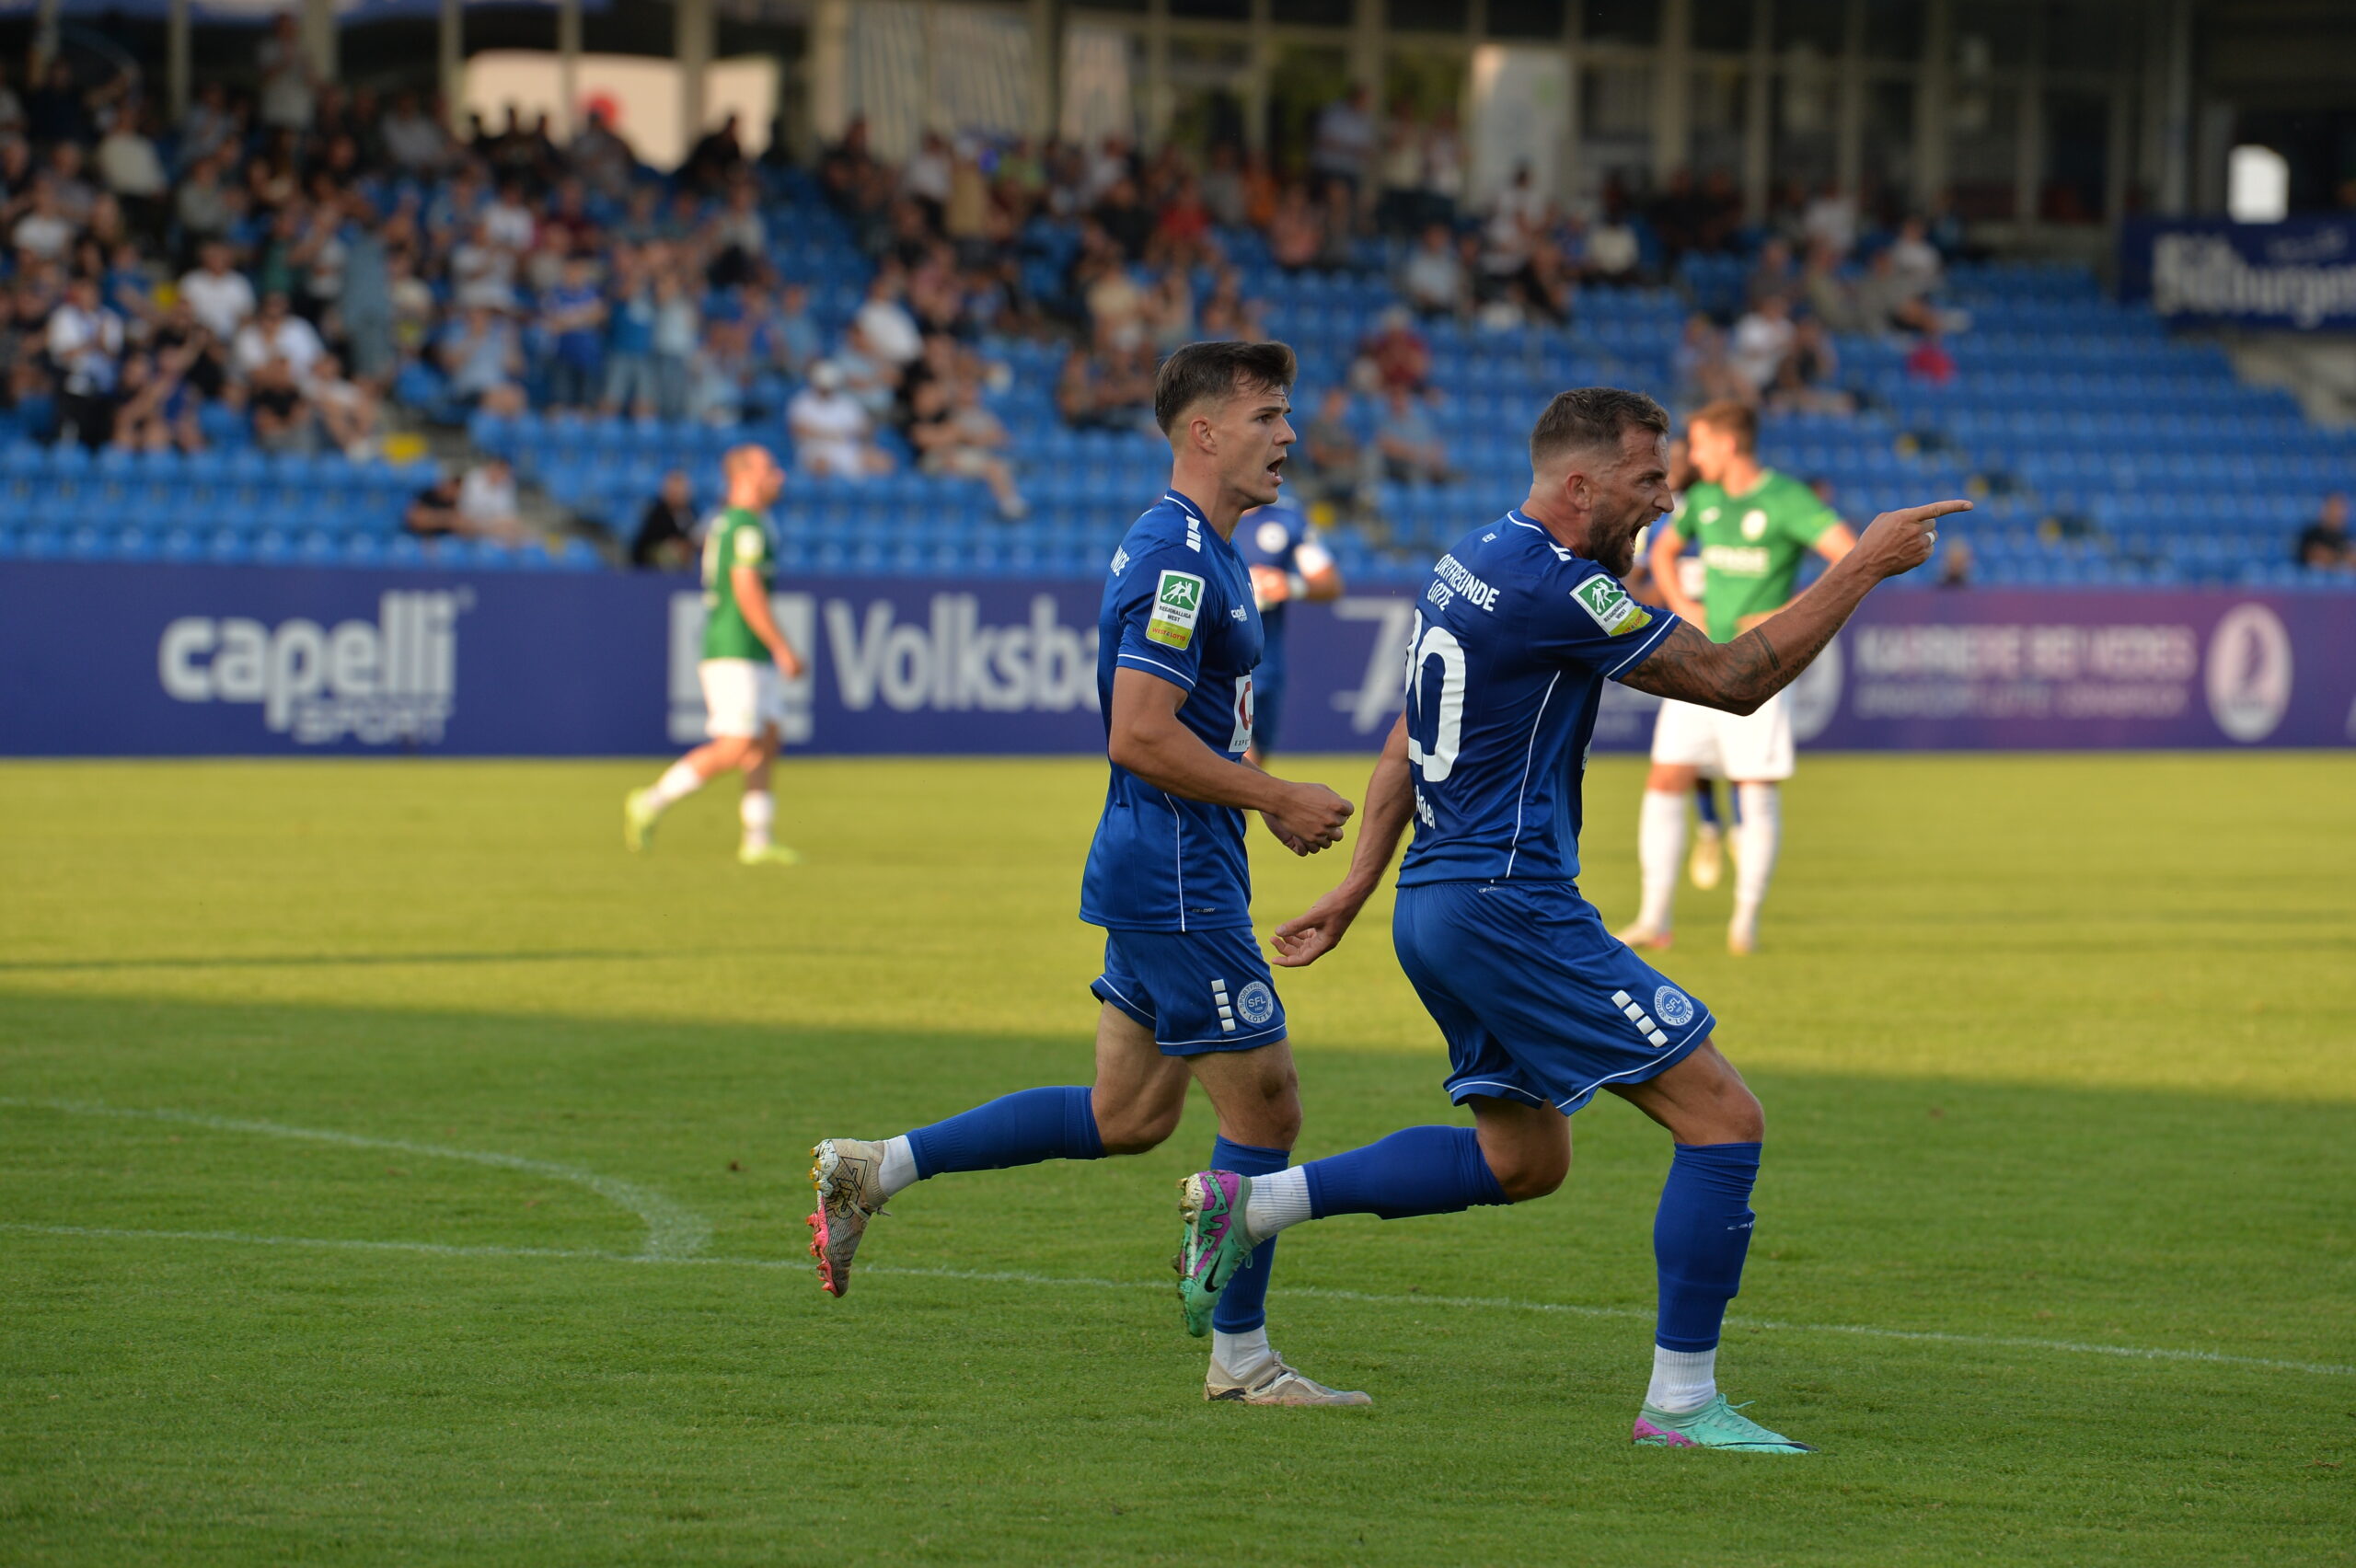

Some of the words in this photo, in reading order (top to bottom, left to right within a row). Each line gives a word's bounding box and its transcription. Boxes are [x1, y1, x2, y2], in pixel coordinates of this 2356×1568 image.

[1426, 579, 1454, 612] LOTTE
[1159, 605, 1191, 619] REGIONALLIGA
[1167, 614, 1181, 622] WEST
[158, 589, 457, 733] capelli
[1248, 996, 1266, 1008] SFL
[1666, 997, 1681, 1012] SFL
[1248, 1011, 1271, 1022] LOTTE
[1675, 1007, 1692, 1024] LOTTE
